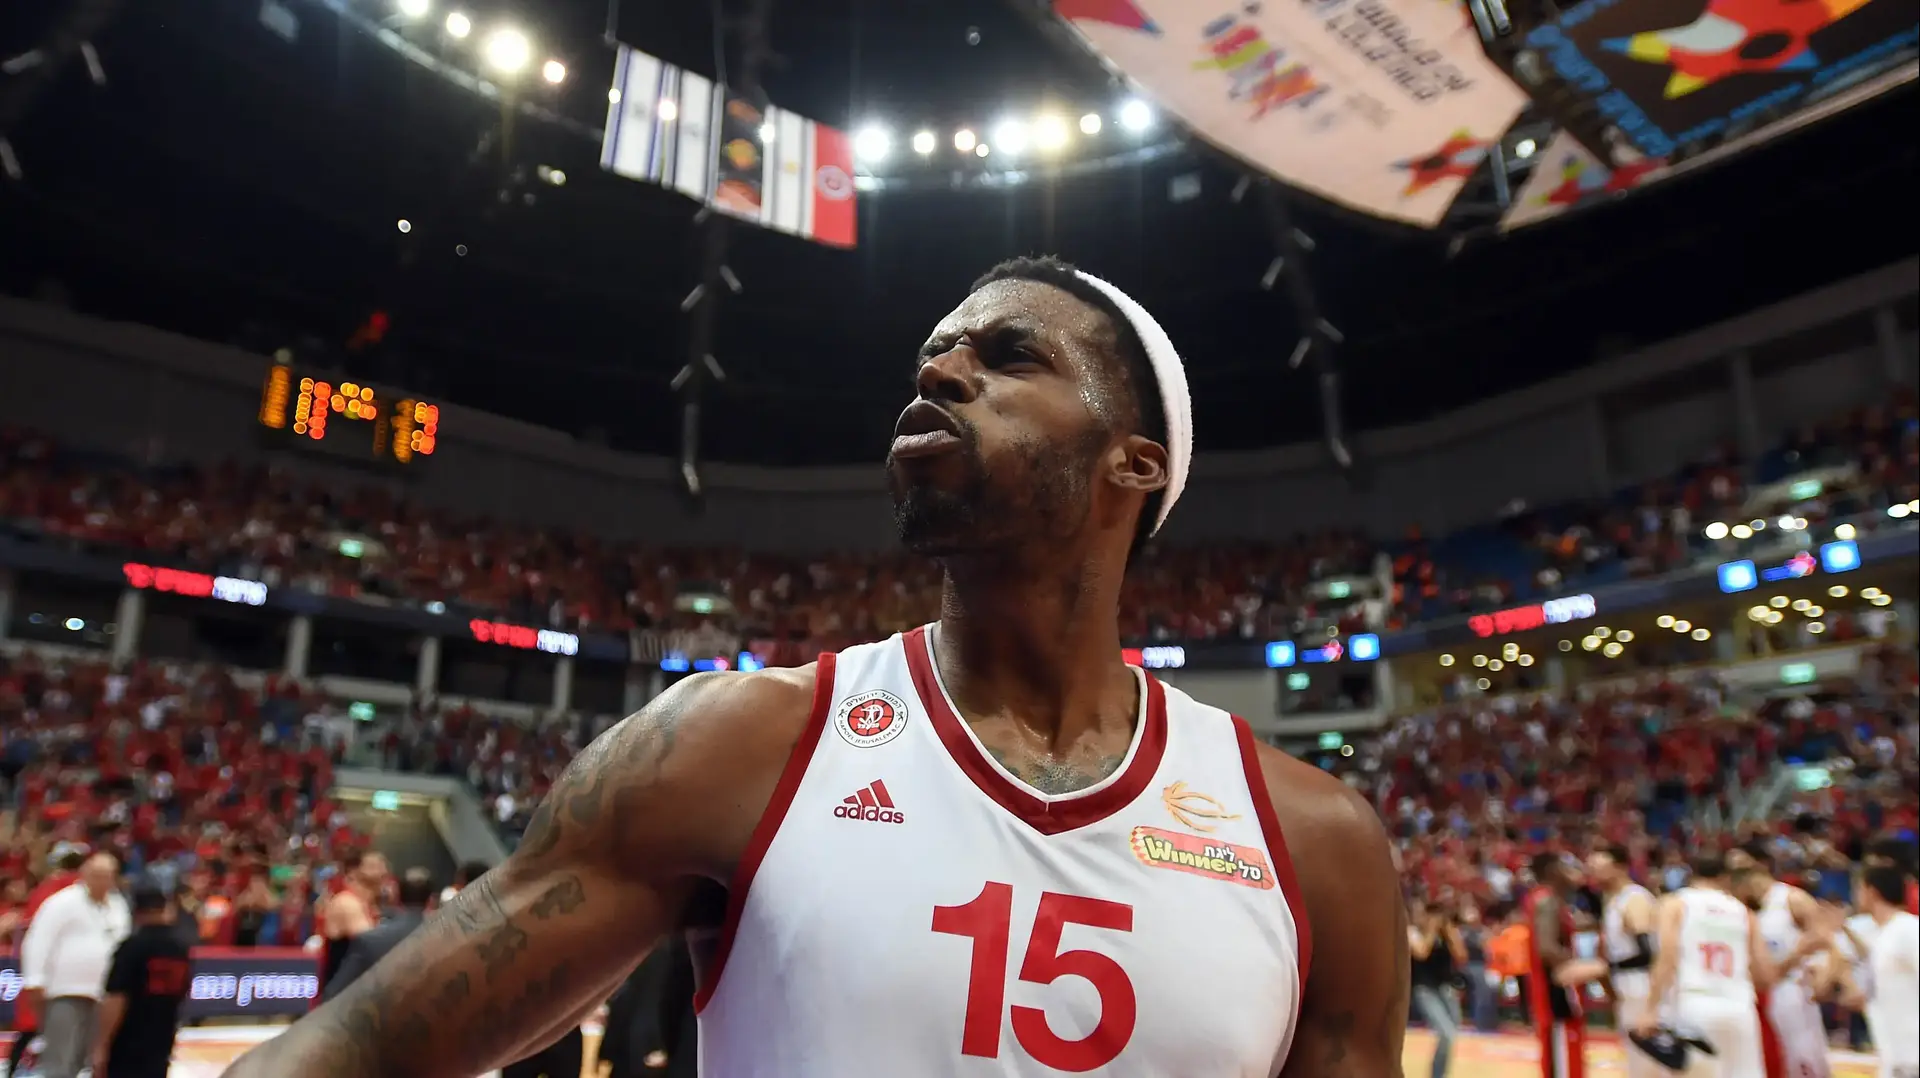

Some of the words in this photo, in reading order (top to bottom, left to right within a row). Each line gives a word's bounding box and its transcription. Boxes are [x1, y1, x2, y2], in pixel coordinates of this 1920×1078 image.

[846, 692, 878, 707] ירושלים
[854, 731, 892, 744] JERUSALEM
[833, 804, 905, 824] adidas
[1204, 845, 1236, 862] ליגת
[1238, 859, 1262, 880] סל
[931, 880, 1137, 1072] 15
